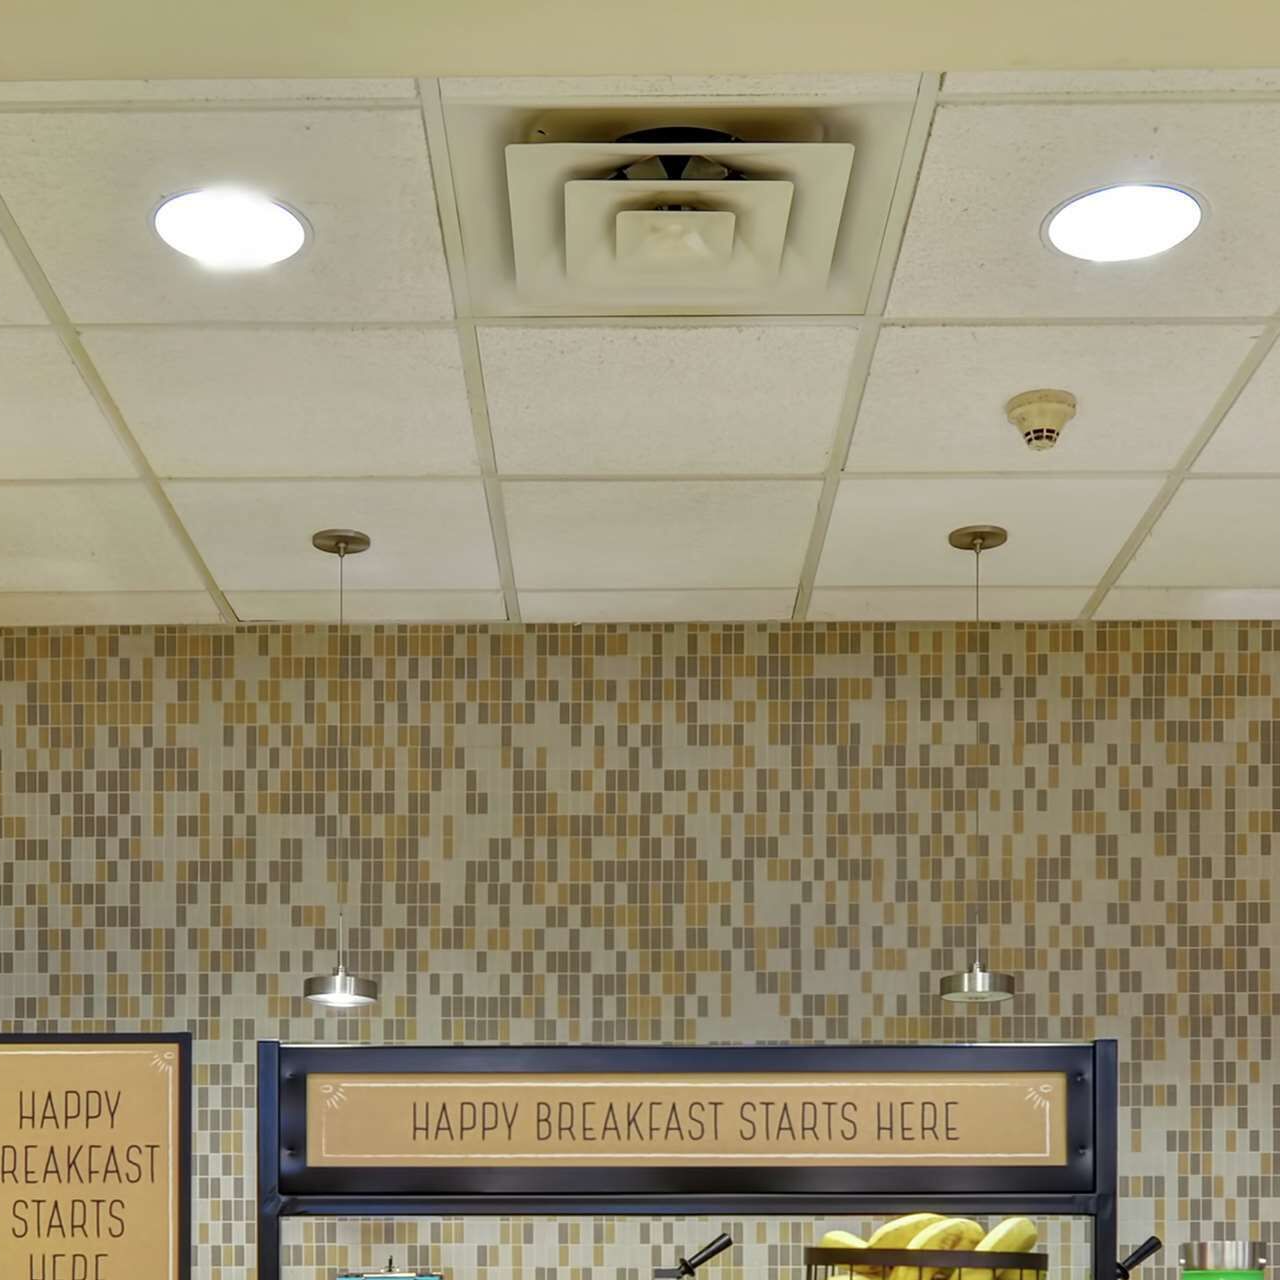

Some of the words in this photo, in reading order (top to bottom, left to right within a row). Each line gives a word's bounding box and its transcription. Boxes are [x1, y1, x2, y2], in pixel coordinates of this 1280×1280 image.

[19, 1090, 121, 1129] HAPPY
[412, 1101, 519, 1141] HAPPY
[536, 1101, 724, 1141] BREAKFAST
[739, 1101, 858, 1141] STARTS
[876, 1101, 960, 1141] HERE
[11, 1199, 125, 1239] STARTS
